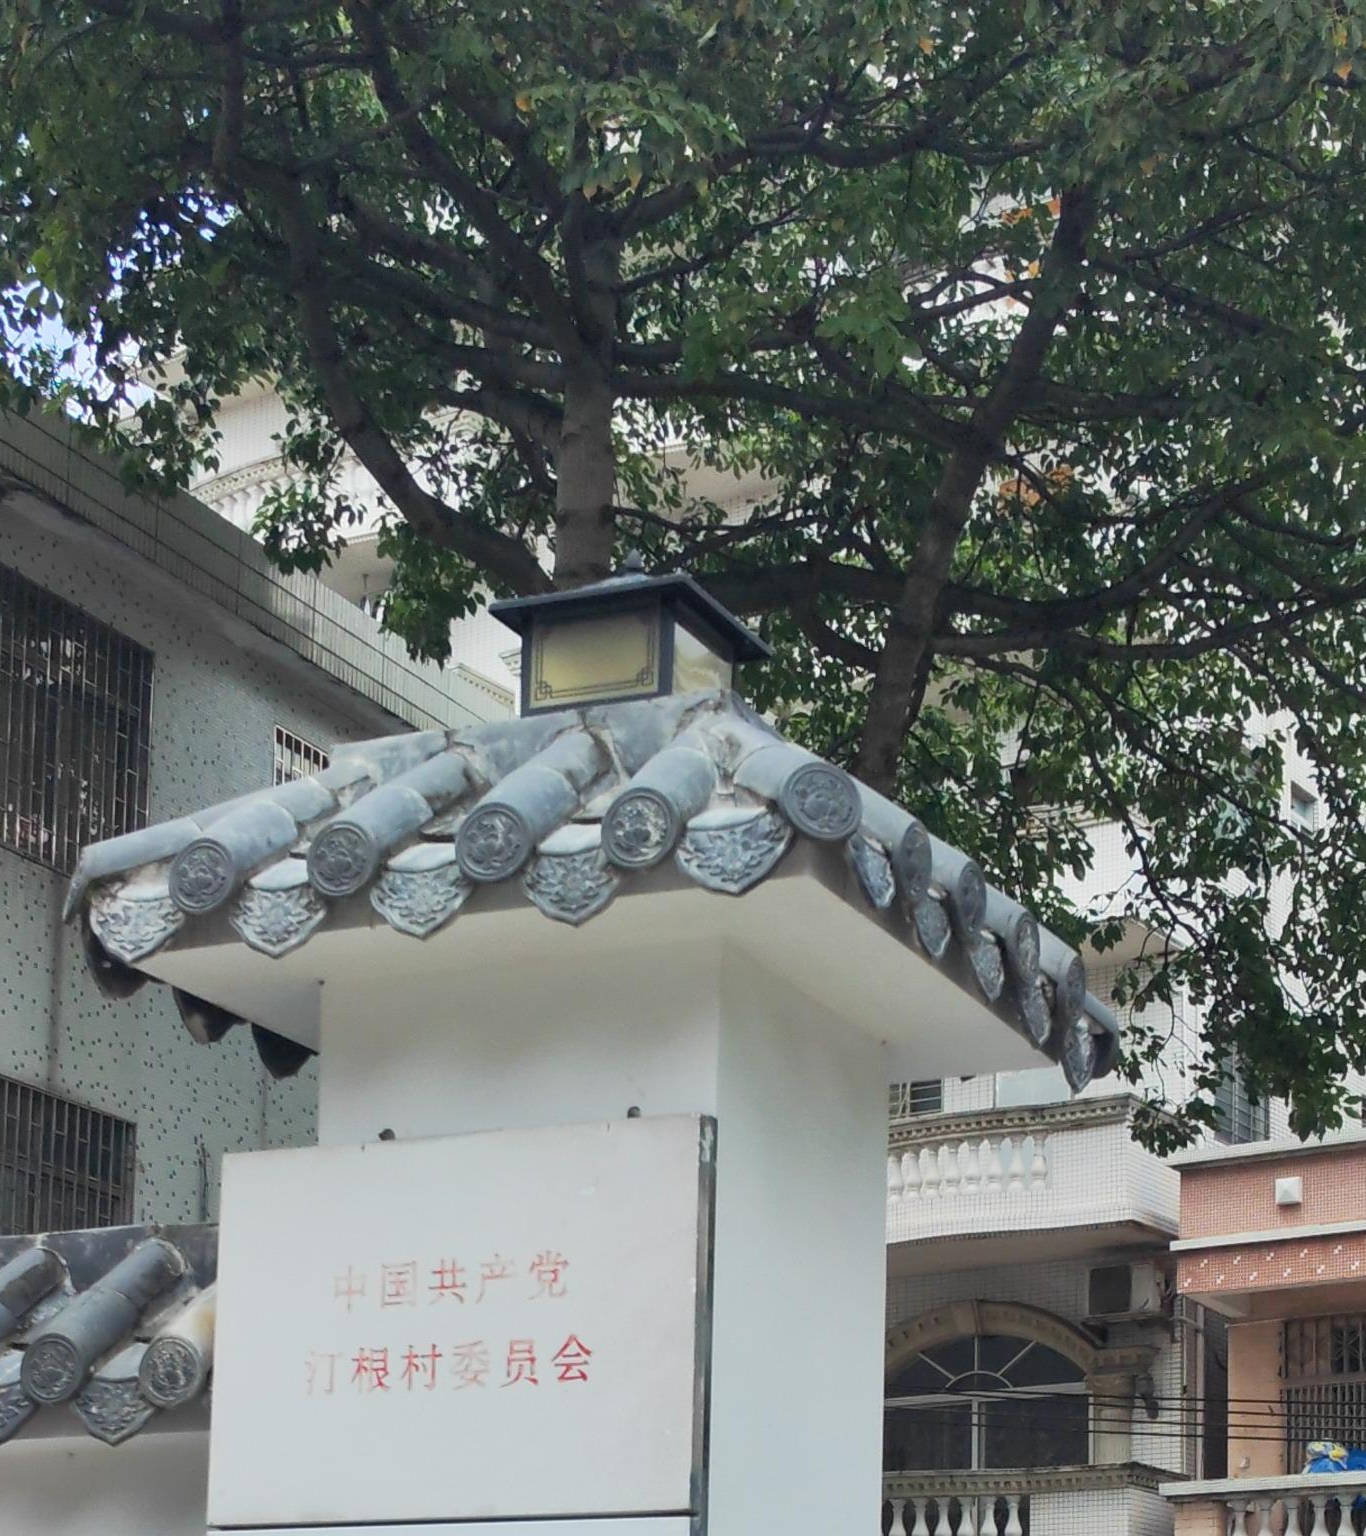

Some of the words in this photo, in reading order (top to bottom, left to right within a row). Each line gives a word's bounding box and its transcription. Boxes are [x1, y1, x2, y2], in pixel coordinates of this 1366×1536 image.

[334, 1250, 571, 1313] 中国共产党
[304, 1333, 594, 1395] 汀根村委员会
